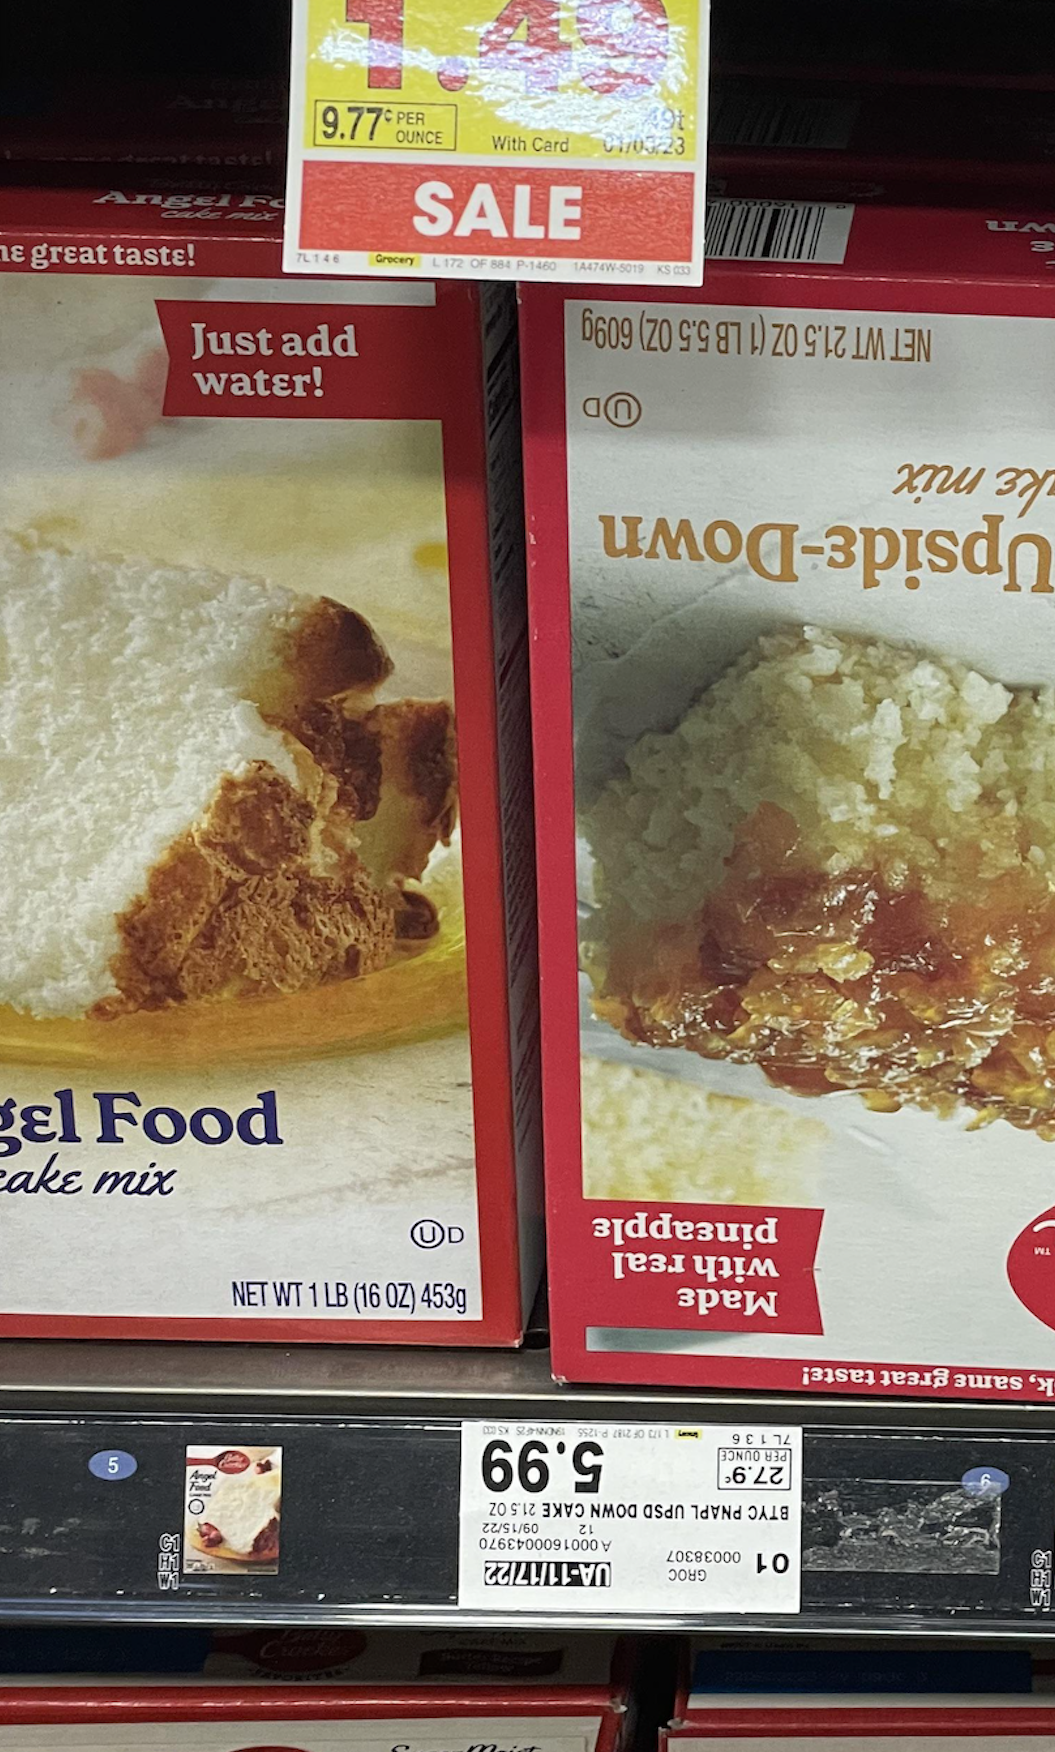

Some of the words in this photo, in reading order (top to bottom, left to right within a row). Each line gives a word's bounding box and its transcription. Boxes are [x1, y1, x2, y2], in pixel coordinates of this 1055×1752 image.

[397, 111, 425, 125] PER
[396, 130, 443, 145] OUNCE
[492, 134, 527, 152] With
[532, 137, 570, 154] Card
[94, 190, 231, 210] Angel
[412, 181, 583, 240] SALE
[30, 243, 107, 269] great
[112, 243, 196, 267] taste!
[190, 322, 274, 360] Just
[281, 324, 359, 357] add
[582, 309, 633, 350] 609g
[641, 310, 672, 352] OZ)
[679, 319, 708, 353] 5.5
[717, 321, 742, 355] LB
[751, 314, 766, 356] (1
[771, 322, 798, 357] OZ
[805, 325, 846, 359] 21.5
[852, 326, 886, 361] WT
[891, 328, 931, 362] NET
[193, 366, 325, 398] water!
[892, 463, 987, 504] mix
[598, 514, 1055, 594] Upside-Down
[92, 1090, 283, 1146] Food
[92, 1163, 177, 1196] mix
[592, 1212, 778, 1250] pineapple
[611, 1252, 685, 1280] real
[692, 1254, 779, 1283] with
[232, 1281, 269, 1307] NET
[273, 1281, 304, 1308] WT
[308, 1283, 317, 1308] 1
[324, 1283, 348, 1309] LB
[353, 1283, 380, 1314] (16
[385, 1283, 416, 1314] OZ)
[421, 1284, 467, 1315] 453g
[677, 1287, 778, 1317] Made
[802, 1366, 875, 1386] taste!
[880, 1367, 950, 1387] great
[953, 1372, 1023, 1390] same
[108, 1457, 119, 1474] 5
[481, 1440, 604, 1493] 5.99
[720, 1449, 761, 1461] OUNCE
[765, 1450, 787, 1462] PER
[489, 1502, 507, 1516] OZ
[511, 1502, 536, 1516] 21.5
[542, 1502, 585, 1518] CAKE
[591, 1503, 637, 1519] DOWN
[643, 1503, 685, 1519] UPSD
[691, 1504, 742, 1520] PNAPL
[748, 1504, 789, 1520] BTYC
[482, 1522, 539, 1534] 09/15/22
[578, 1524, 594, 1535] 12
[479, 1537, 598, 1551] 0001600043970
[666, 1550, 741, 1564] 00038307
[756, 1553, 789, 1574] 01
[484, 1562, 611, 1586] UA-11/17/22
[668, 1568, 707, 1582] GROC
